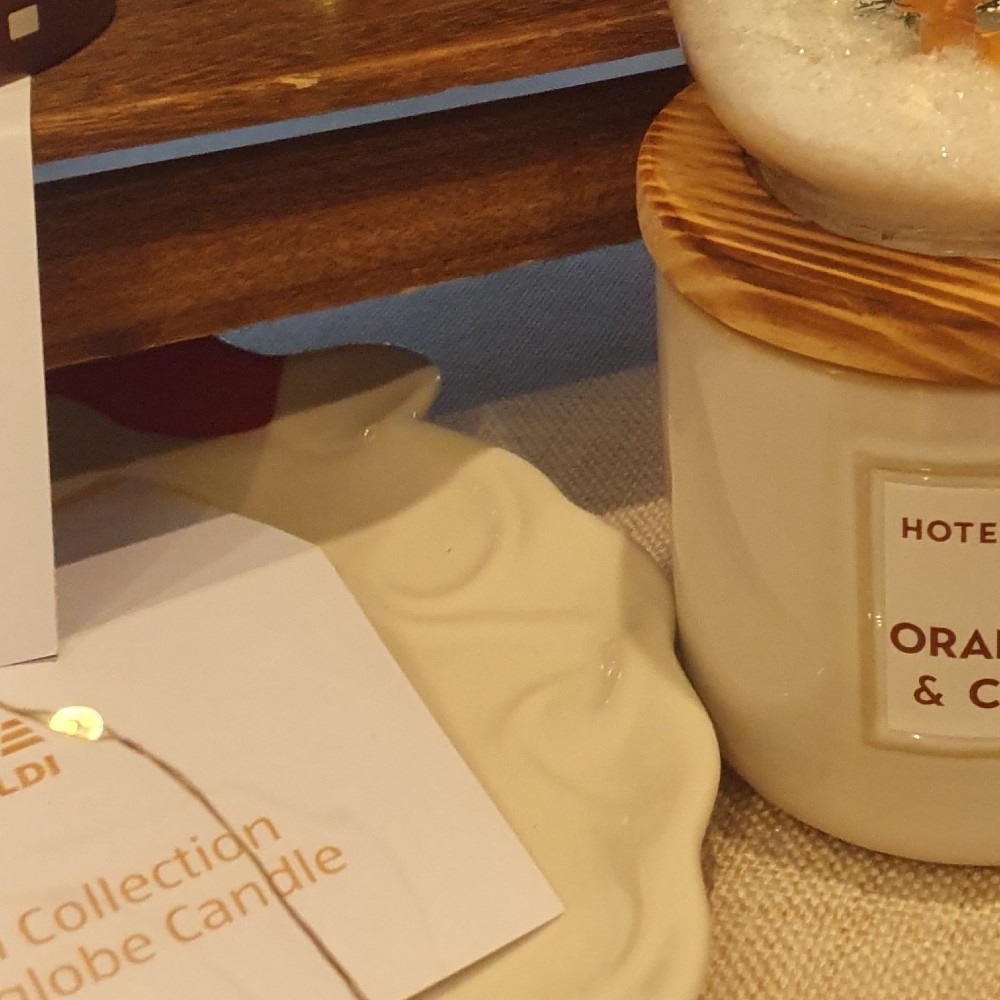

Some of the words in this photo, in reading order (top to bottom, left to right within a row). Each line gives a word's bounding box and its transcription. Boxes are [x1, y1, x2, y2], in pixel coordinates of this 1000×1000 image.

[913, 674, 945, 706] &
[17, 815, 281, 945] Collection
[165, 844, 347, 944] Candle
